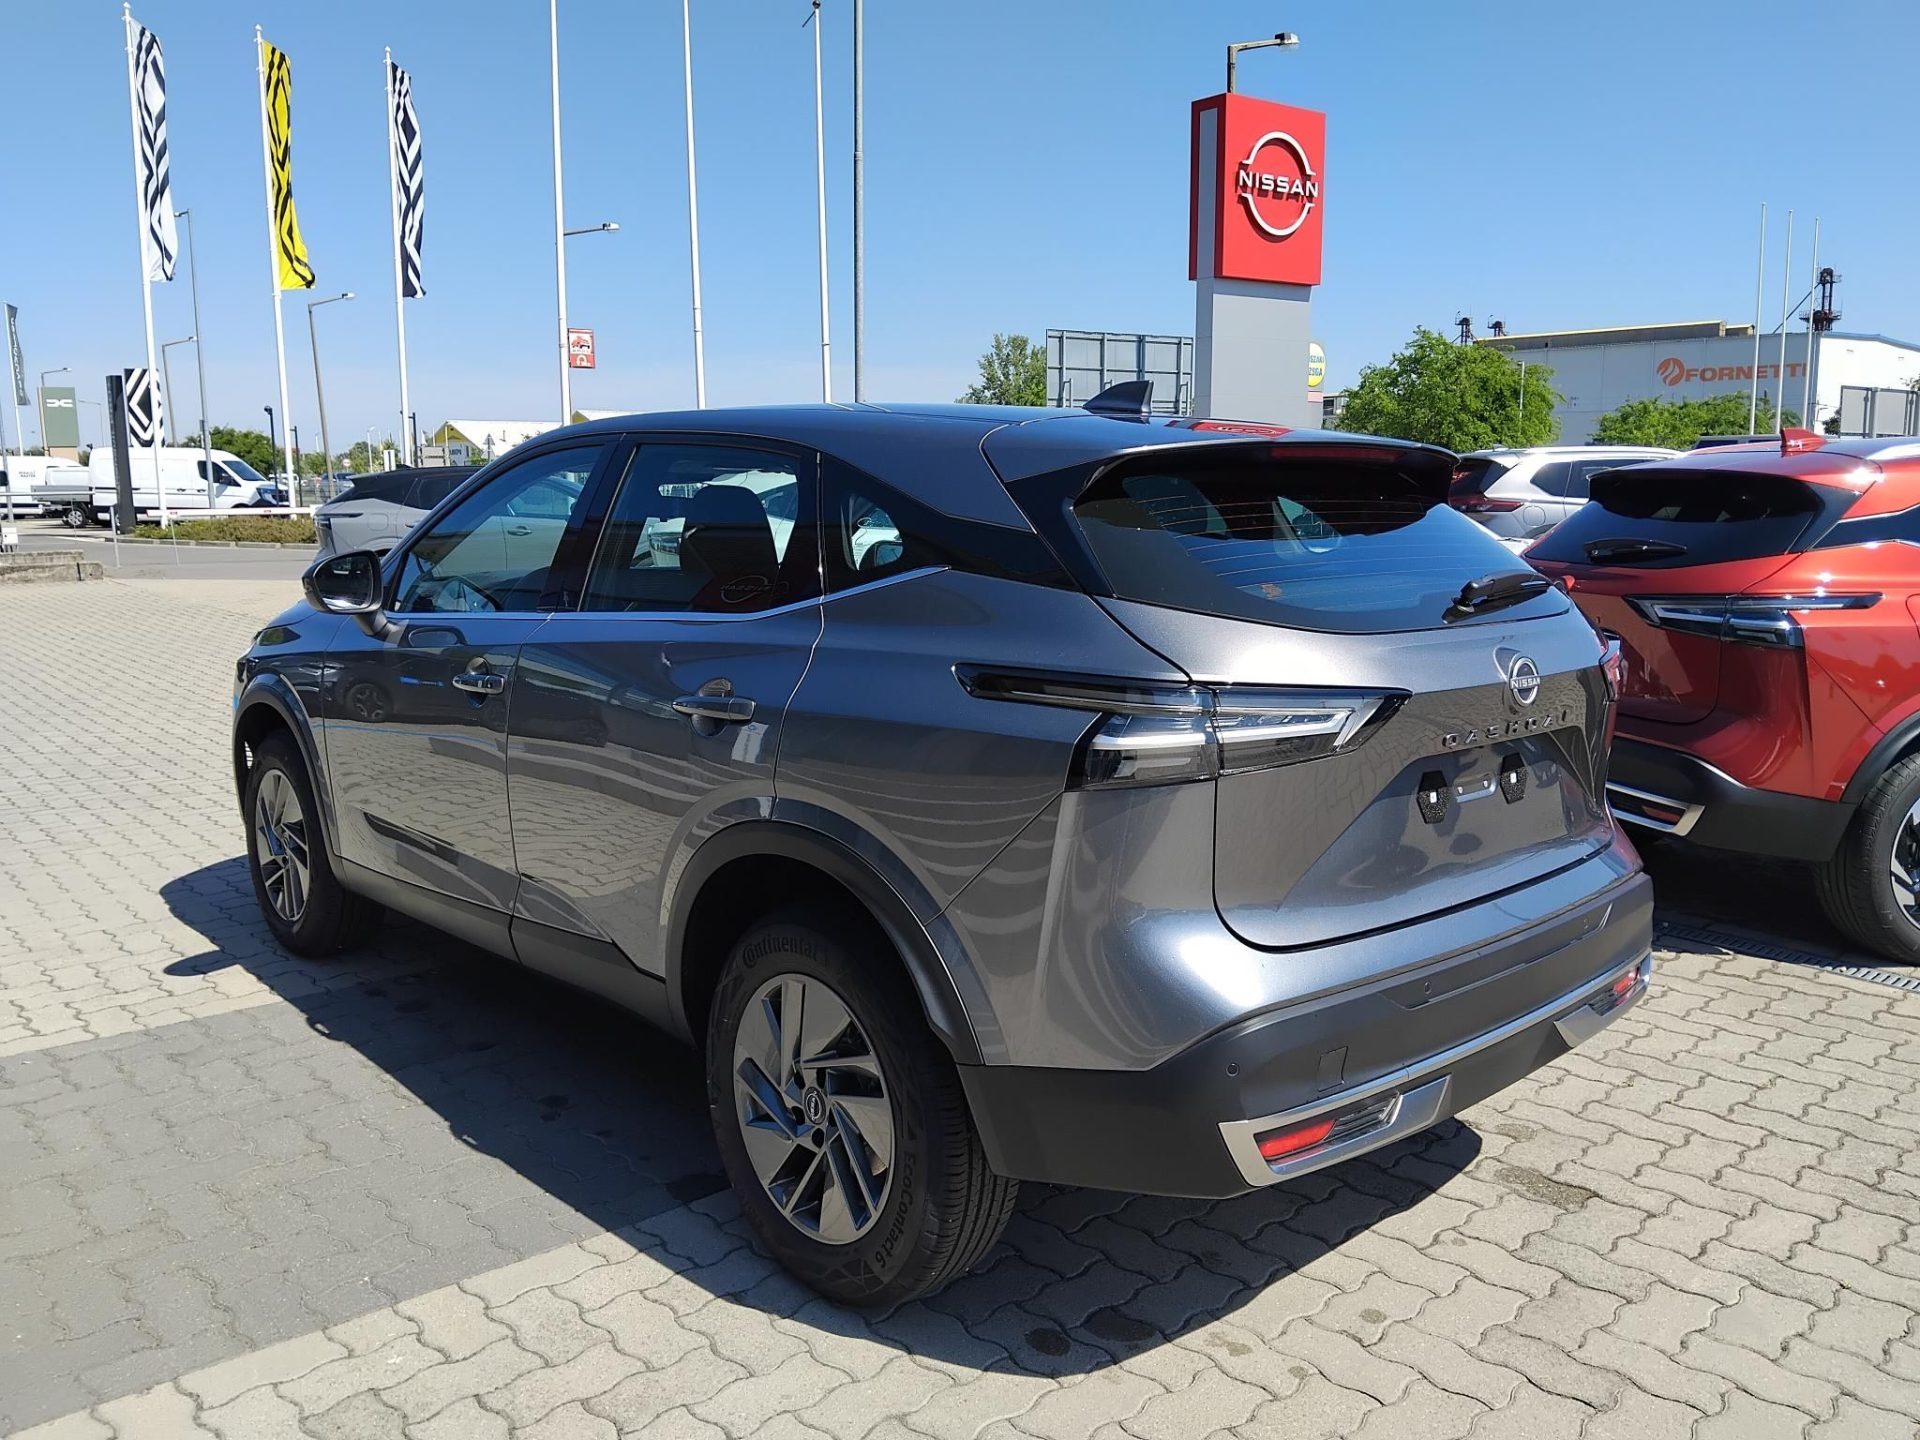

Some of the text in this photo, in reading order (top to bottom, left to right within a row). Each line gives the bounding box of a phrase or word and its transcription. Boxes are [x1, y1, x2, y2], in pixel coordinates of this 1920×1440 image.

[1239, 169, 1318, 198] NISSAN
[1684, 362, 1808, 382] FORNETTI
[1441, 709, 1568, 749] QASHQAI
[743, 933, 817, 968] Continental
